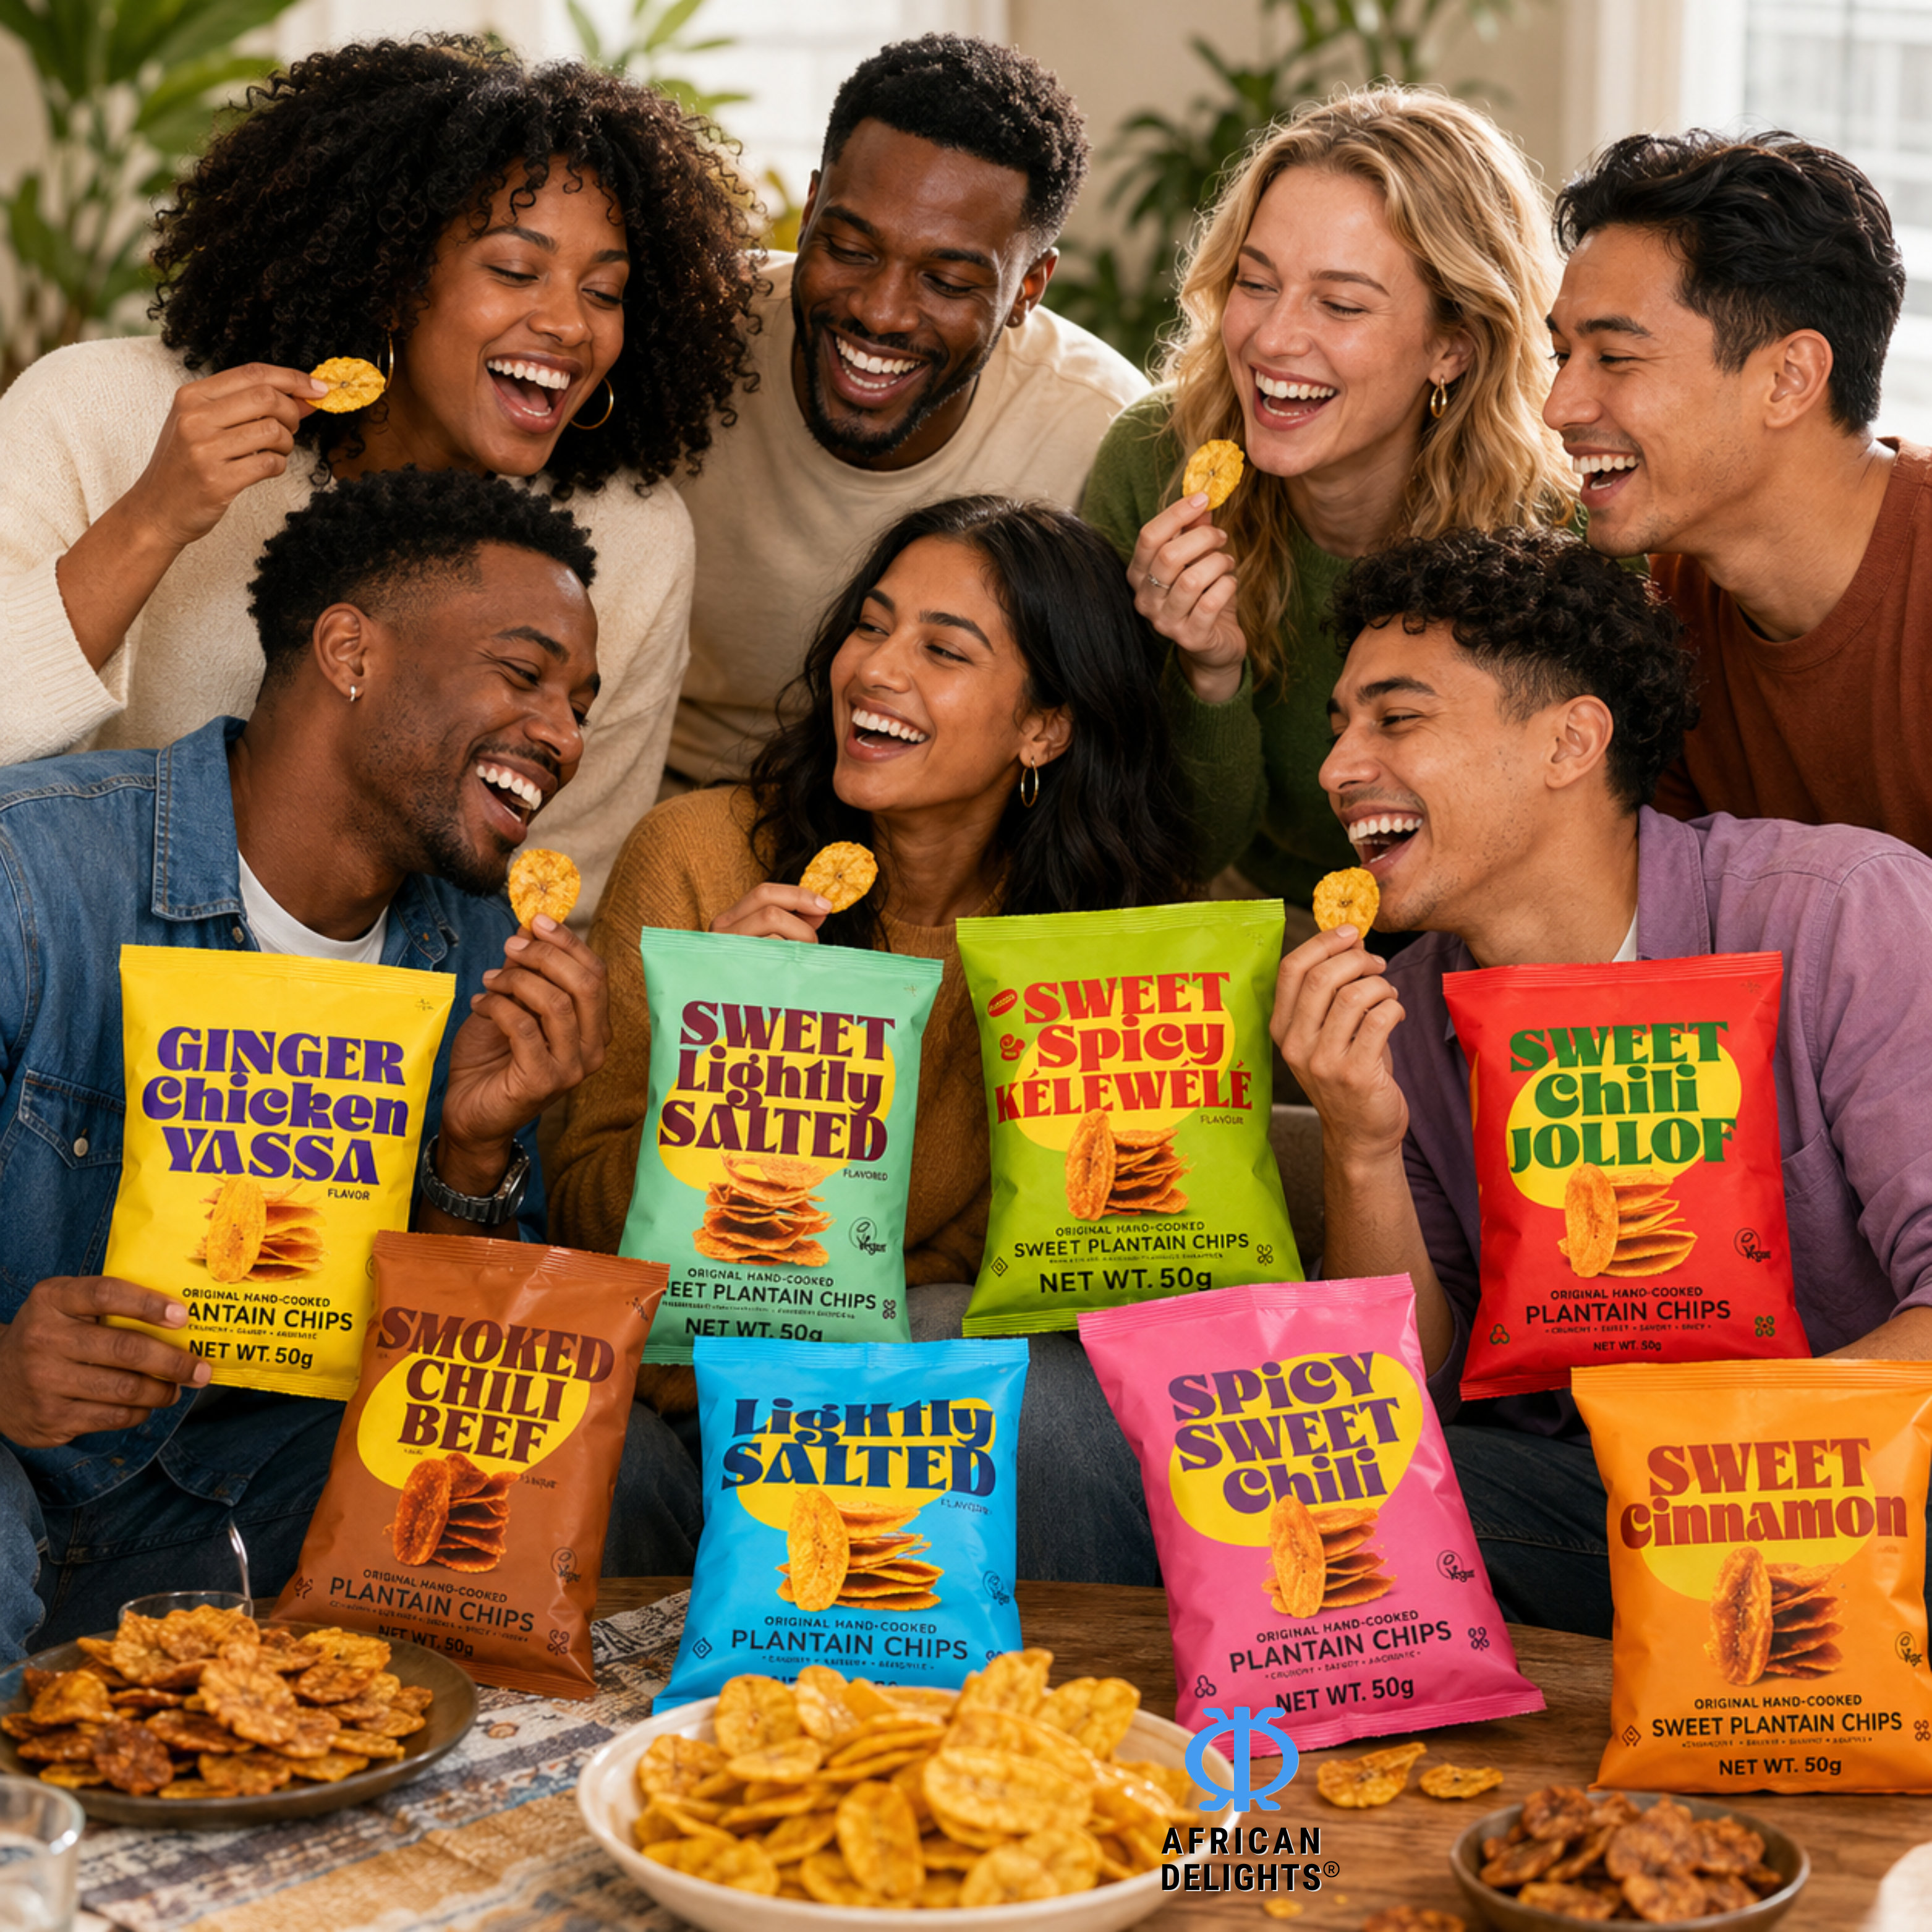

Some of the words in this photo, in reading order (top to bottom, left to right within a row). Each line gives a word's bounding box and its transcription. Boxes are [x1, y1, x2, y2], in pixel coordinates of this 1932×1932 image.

[1024, 971, 1230, 1024] SWEET
[680, 1000, 896, 1061] SWEET
[1037, 1013, 1225, 1073] Spicy
[1509, 1021, 1729, 1073] SWEET
[156, 1026, 405, 1086] GINGER
[676, 1044, 884, 1113] Lightly
[994, 1060, 1253, 1125] KÉLEWÉLÉ
[1534, 1063, 1700, 1118] Chili
[142, 1072, 409, 1137] Chicken
[658, 1100, 888, 1162] SALTED
[1509, 1117, 1736, 1173] JOLLOF
[161, 1126, 380, 1185] YASSA
[843, 1168, 888, 1181] FLAVORED
[328, 1188, 370, 1201] FLAVOR
[1015, 1240, 1081, 1258] SWEET
[1089, 1235, 1186, 1253] PLANTAIN
[1193, 1233, 1249, 1249] CHIPS
[182, 1288, 239, 1301] ORIGINAL
[244, 1293, 330, 1307] HAND-COOKED
[663, 1281, 707, 1298] EET
[713, 1283, 813, 1306] PLANTAIN
[820, 1291, 876, 1310] CHIPS
[747, 1272, 833, 1287] HAND-COOKED
[1040, 1272, 1094, 1293] NET
[1103, 1269, 1153, 1290] WT.
[1160, 1267, 1212, 1291] 50g
[1551, 1289, 1609, 1300] ORIGINAL
[1612, 1286, 1703, 1298] HAND-COOKED
[188, 1301, 275, 1326] ANTAIN
[284, 1309, 353, 1332] CHIPS
[685, 1317, 730, 1336] NET
[736, 1320, 773, 1338] WT.
[780, 1323, 823, 1342] 50g
[1526, 1302, 1647, 1324] PLANTAIN
[1656, 1300, 1731, 1320] CHIPS
[189, 1339, 231, 1359] NET
[237, 1343, 270, 1362] WT.
[274, 1347, 313, 1369] 50g
[376, 1306, 616, 1384] SMOKED
[1593, 1341, 1616, 1351] NET
[1619, 1340, 1638, 1351] WT.
[1641, 1340, 1662, 1351] 50g
[405, 1358, 567, 1422] CHILI
[397, 1402, 548, 1465] BEEF
[1175, 1397, 1400, 1473] SWEET
[721, 1441, 997, 1497] SALTED
[1223, 1447, 1389, 1515] Chili
[1647, 1437, 1871, 1497] SWEET
[363, 1568, 417, 1588] ORIGINAL
[330, 1577, 451, 1617] PLANTAIN
[460, 1601, 534, 1633] CHIPS
[764, 1616, 830, 1628] ORIGINAL
[835, 1620, 937, 1634] HAND-COOKED
[1257, 1625, 1319, 1643] ORIGINAL
[1323, 1610, 1419, 1633] HAND-COOKED
[445, 1636, 474, 1658] 50g
[731, 1629, 873, 1655] PLANTAIN
[884, 1636, 968, 1660] CHIPS
[1229, 1633, 1364, 1673] PLANTAIN
[1372, 1620, 1452, 1649] CHIPS
[1275, 1688, 1319, 1714] NET
[1326, 1682, 1366, 1706] WT.
[1372, 1677, 1415, 1700] 50g
[1695, 1698, 1758, 1709] ORIGINAL
[1763, 1695, 1862, 1708] HAND-COOKED
[1652, 1717, 1723, 1737] SWEET
[1731, 1714, 1834, 1734] PLANTAIN
[1842, 1712, 1902, 1731] CHIPS
[1719, 1759, 1758, 1776] NET
[1764, 1758, 1798, 1774] WT.
[1805, 1756, 1842, 1776] 50g
